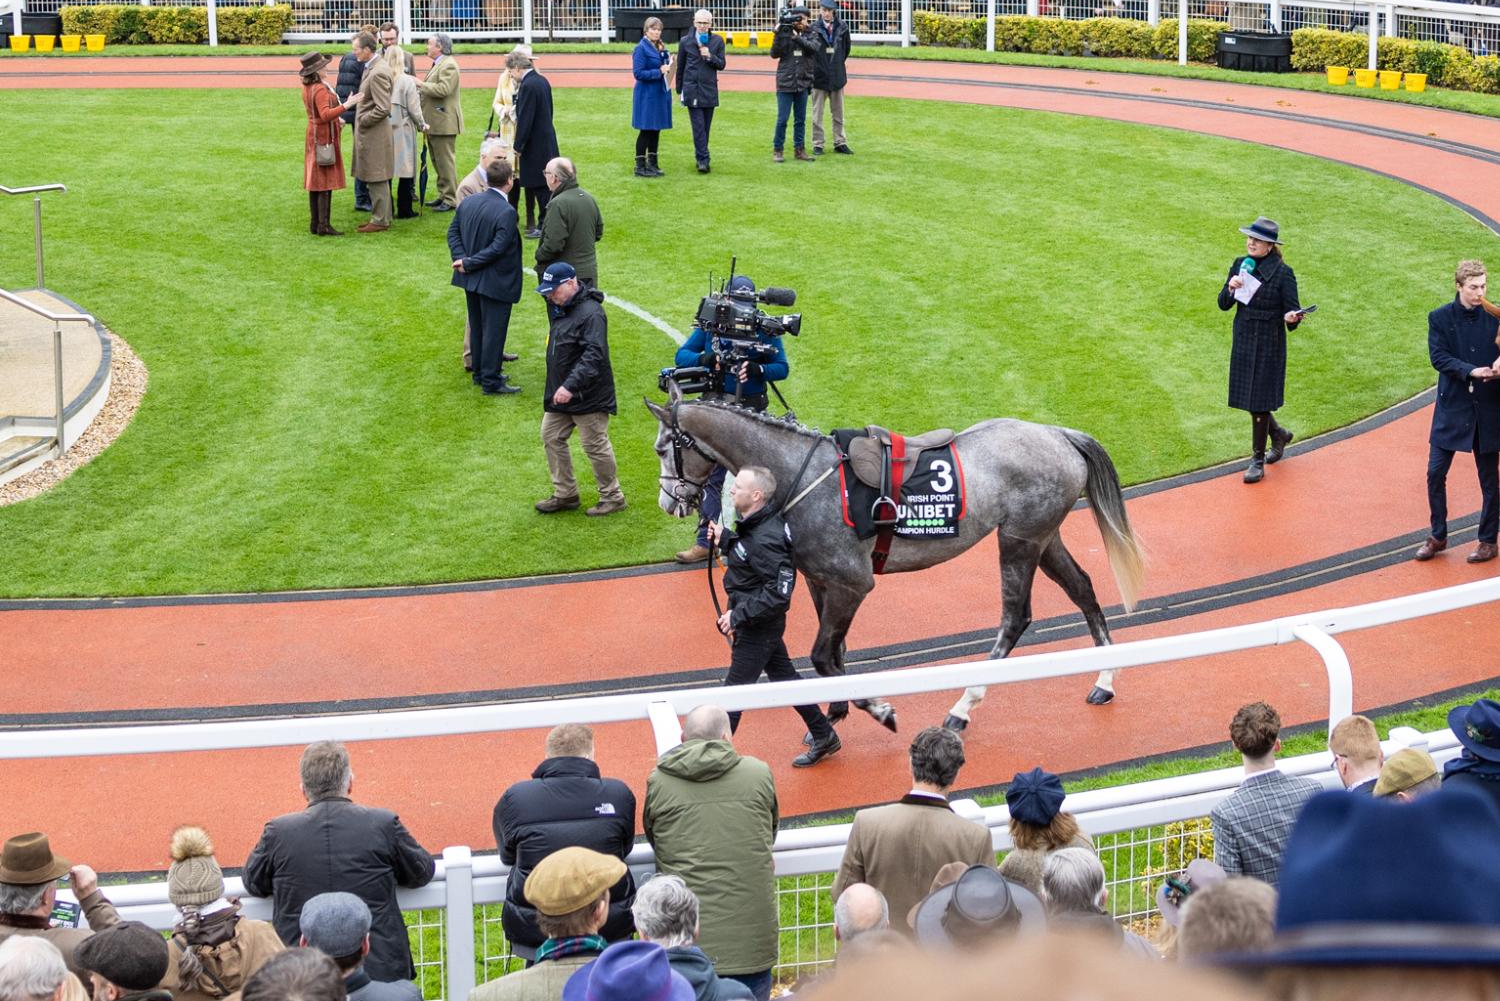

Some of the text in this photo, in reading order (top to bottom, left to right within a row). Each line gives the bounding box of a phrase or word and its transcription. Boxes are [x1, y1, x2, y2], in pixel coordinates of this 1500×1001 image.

[929, 459, 954, 493] 3
[907, 494, 955, 503] IRISH POINT
[897, 503, 956, 519] UNIBET
[894, 526, 955, 535] AMPION HURDLE
